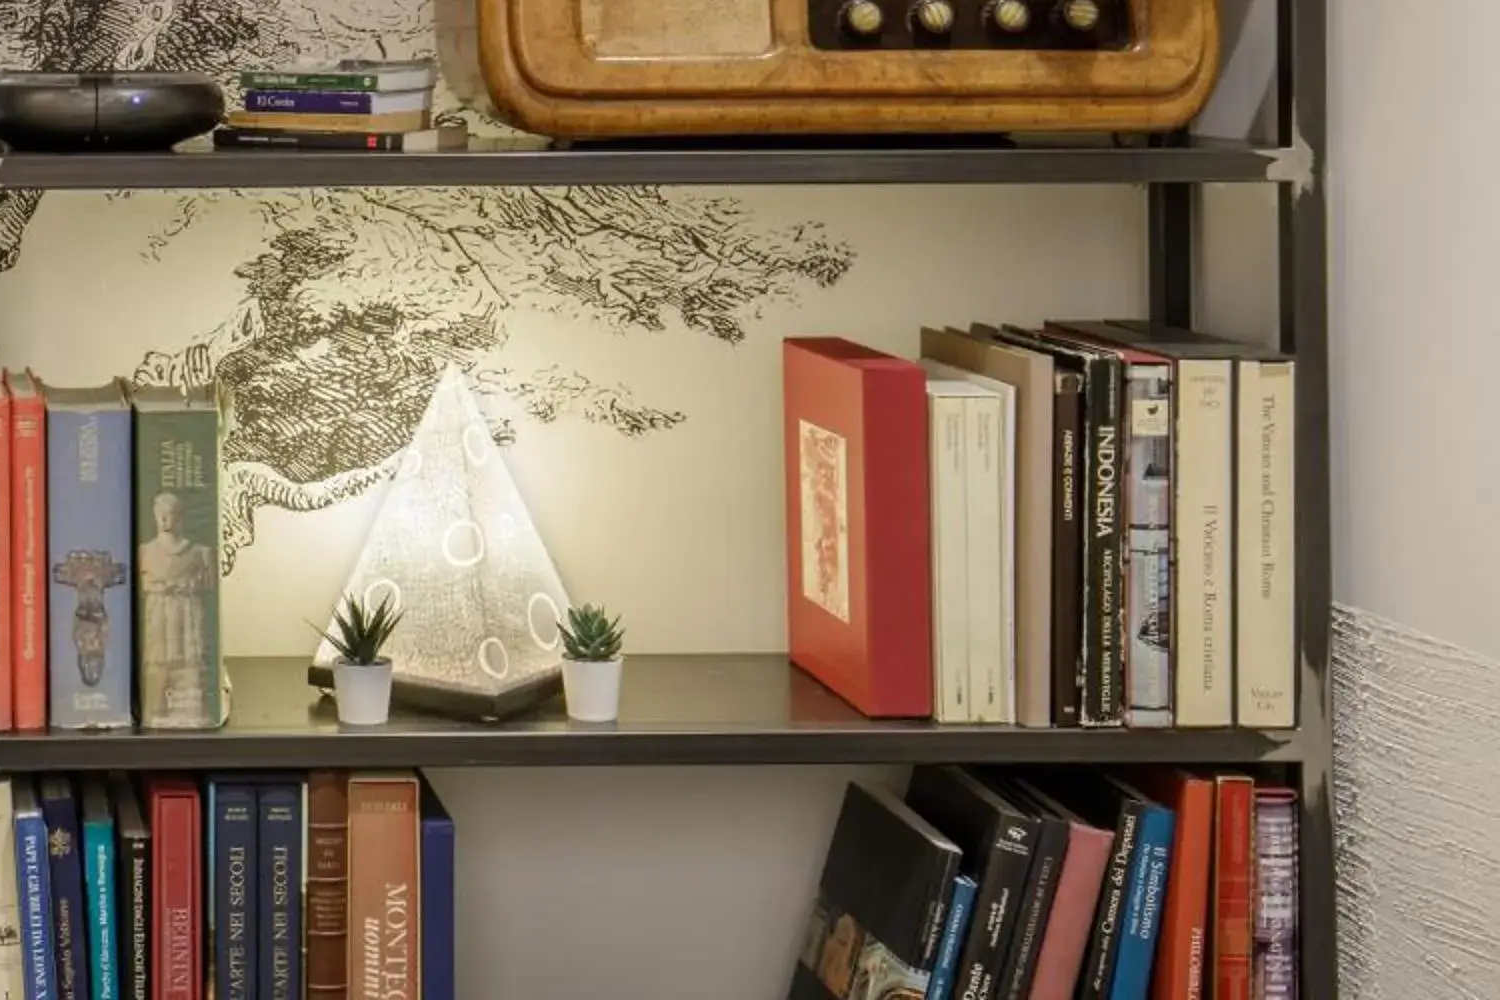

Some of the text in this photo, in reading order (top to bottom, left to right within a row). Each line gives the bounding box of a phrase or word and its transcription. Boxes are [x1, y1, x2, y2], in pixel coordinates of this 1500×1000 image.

[1262, 394, 1275, 420] The
[161, 438, 175, 488] ITALIA
[1262, 422, 1275, 469] Vatican
[1097, 426, 1115, 537] INDONESIA
[1261, 473, 1275, 497] and
[1203, 505, 1218, 515] Il
[1260, 562, 1274, 600] Rome
[1203, 592, 1217, 632] Roma
[1115, 813, 1137, 866] Deputati
[228, 846, 245, 906] SECOLI
[273, 846, 289, 905] SECOLI
[1111, 867, 1125, 886] dei
[1140, 847, 1167, 939] Il Simbolismo
[229, 911, 245, 941] NEI
[273, 911, 289, 940] NEI
[1101, 889, 1121, 935] Camera
[172, 908, 189, 992] BERNINI
